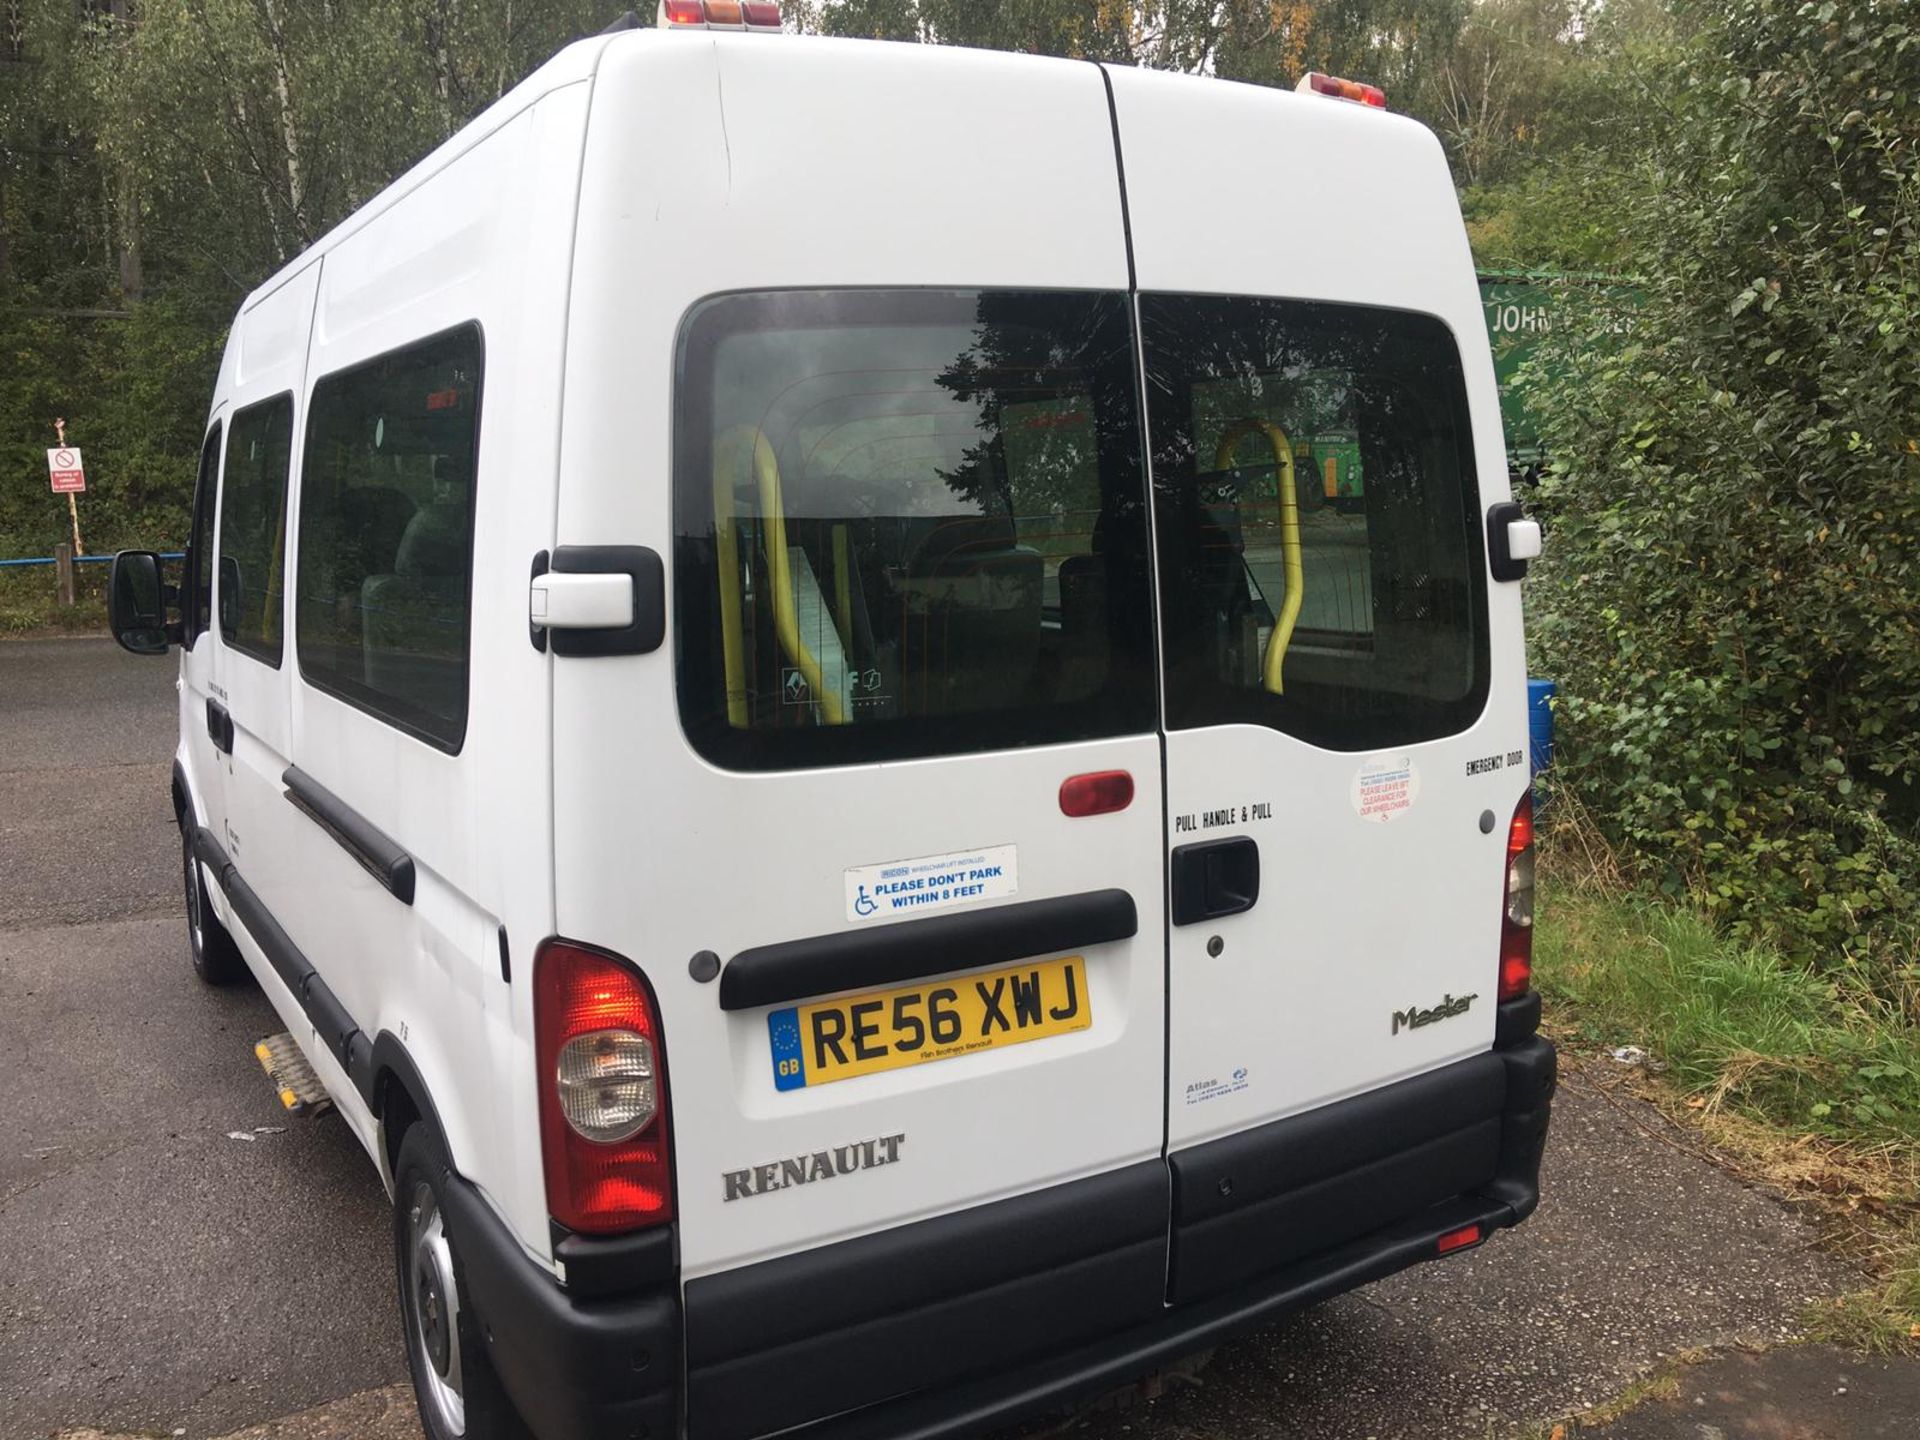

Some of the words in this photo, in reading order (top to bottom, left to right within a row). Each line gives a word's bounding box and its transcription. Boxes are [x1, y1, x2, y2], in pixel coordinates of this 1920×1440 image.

[1492, 305, 1553, 332] JOHN
[1466, 755, 1503, 776] EMERGENCY
[1506, 750, 1523, 767] DOOR
[1363, 793, 1396, 806] CLEARANCE
[1176, 814, 1197, 832] PULL
[1203, 808, 1236, 828] HANDLE
[1241, 806, 1248, 822] &
[1252, 803, 1272, 820] PULL
[875, 879, 924, 896] PLEASE
[928, 872, 966, 887] DON'T
[970, 866, 1002, 880] PARK
[892, 891, 939, 908] WITHIN
[942, 889, 950, 900] 8
[954, 884, 985, 897] FEET
[811, 988, 962, 1069] RE56
[975, 965, 1078, 1036] XWJ
[778, 1058, 800, 1077] GB
[1186, 1079, 1218, 1094] Atlas
[723, 1133, 905, 1202] RENAULT
